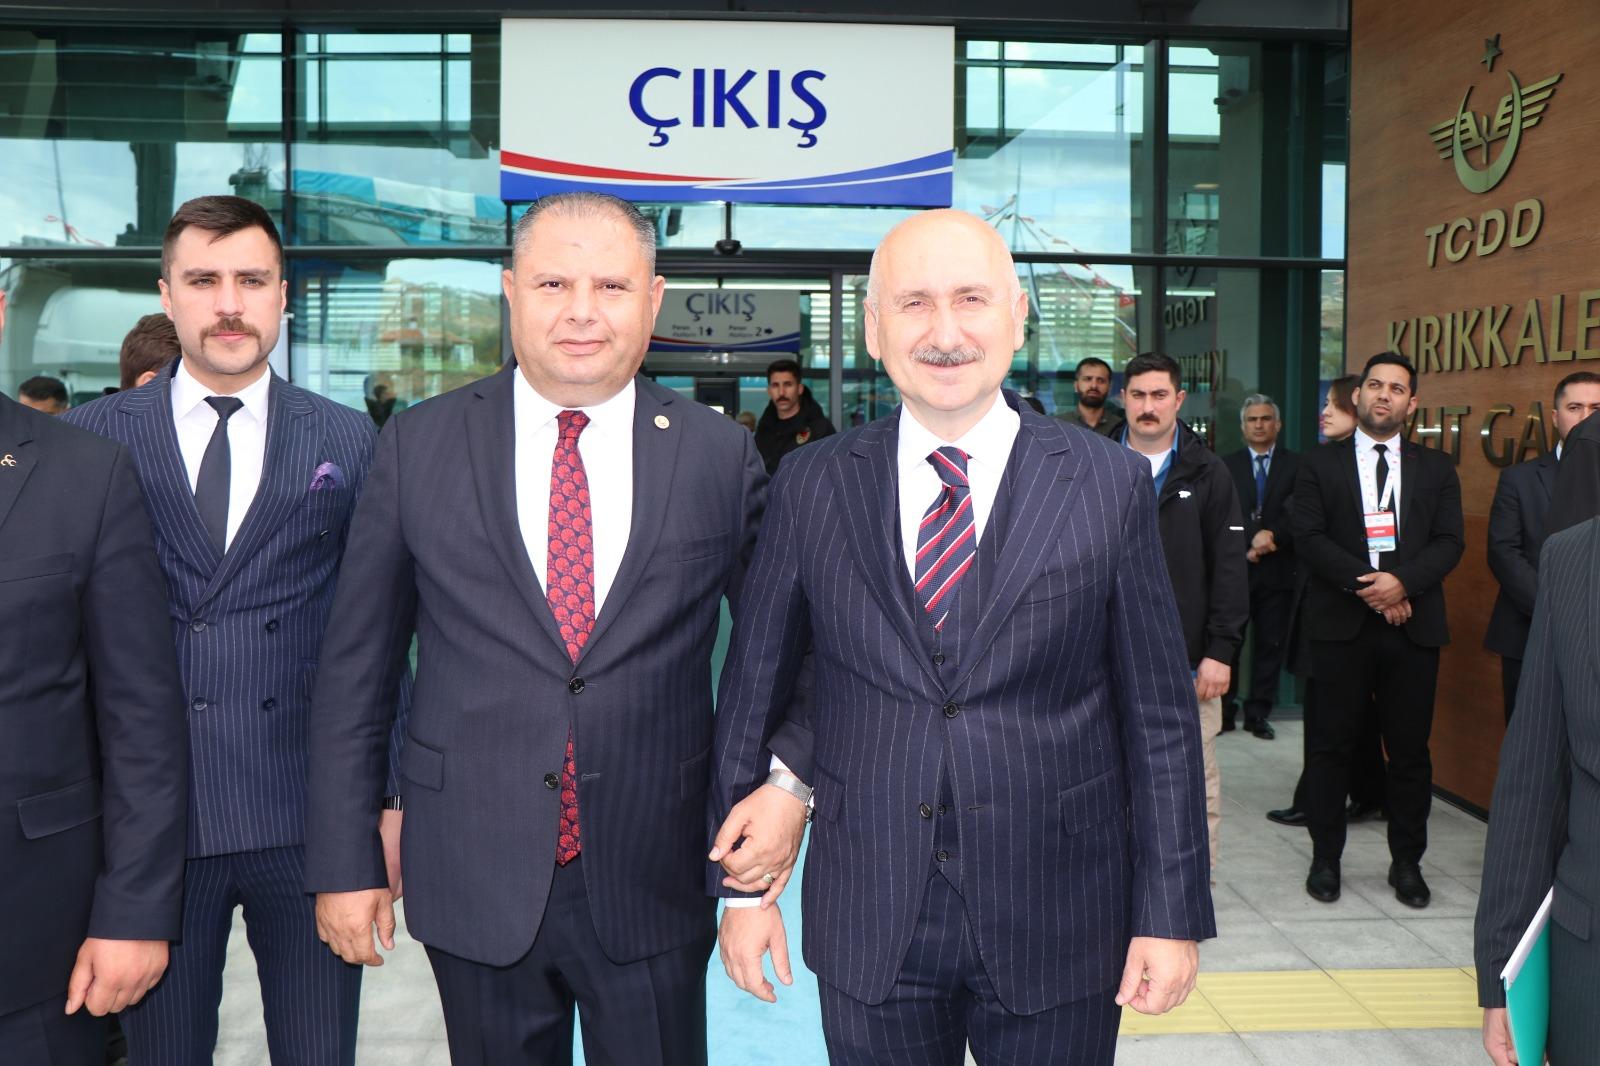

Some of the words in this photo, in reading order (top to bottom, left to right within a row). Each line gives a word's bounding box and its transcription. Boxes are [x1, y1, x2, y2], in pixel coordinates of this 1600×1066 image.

[629, 67, 827, 148] ÇIKIŞ
[1424, 198, 1544, 268] TCDD
[685, 292, 756, 321] ÇIKIŞ
[755, 327, 762, 337] 2
[1480, 402, 1562, 468] GA
